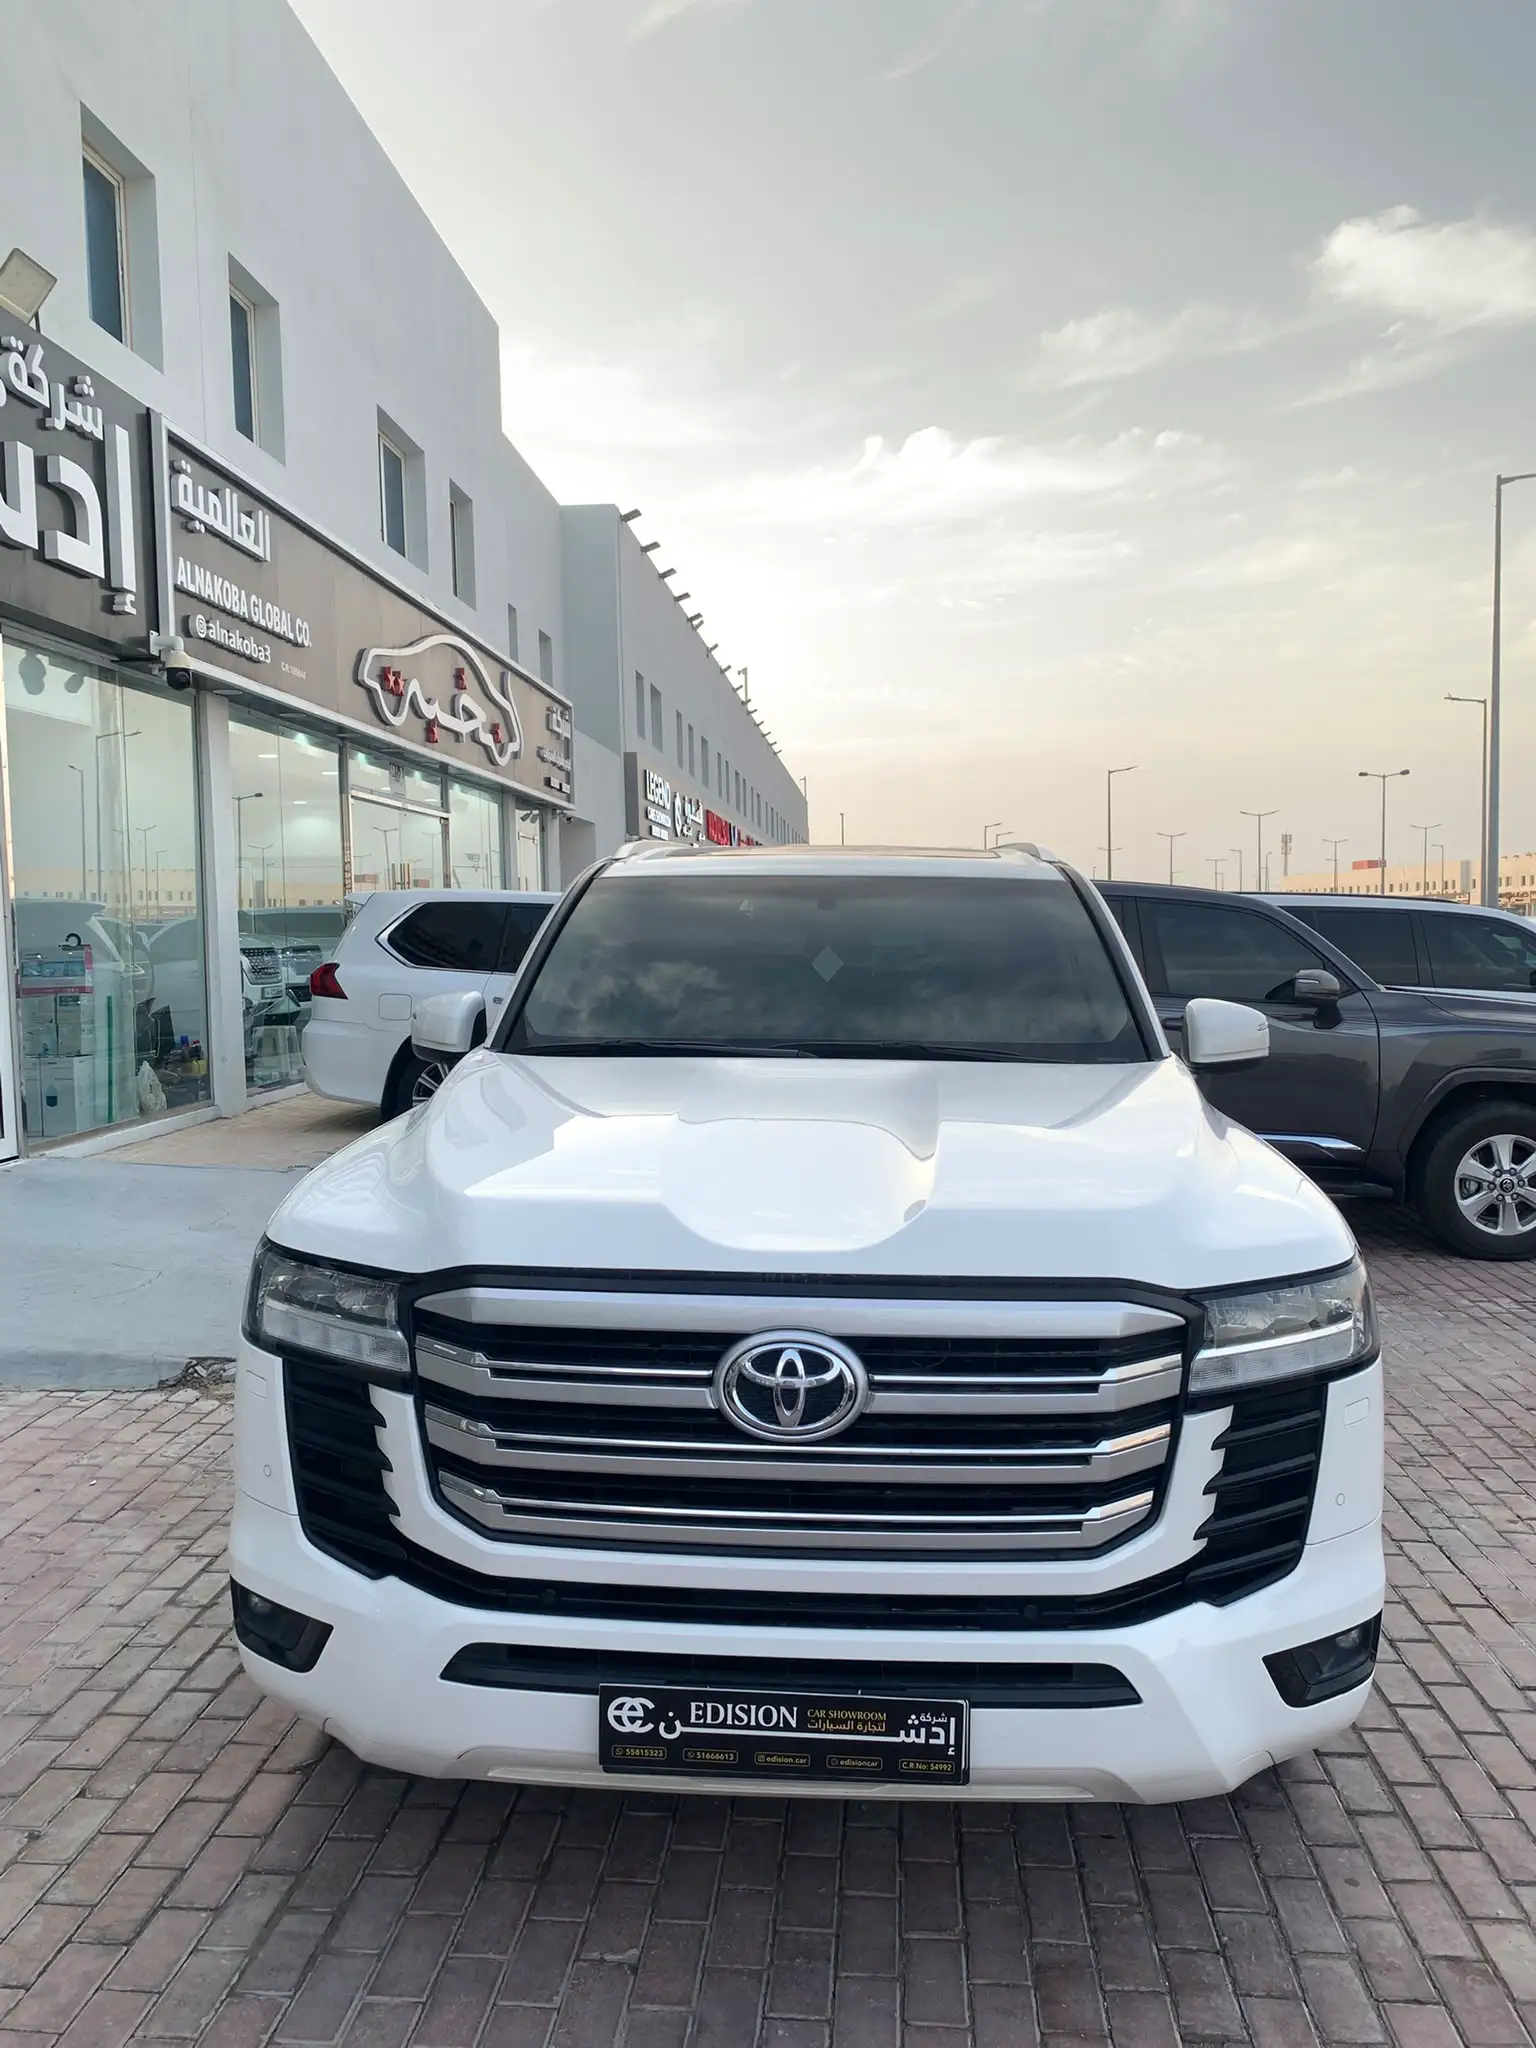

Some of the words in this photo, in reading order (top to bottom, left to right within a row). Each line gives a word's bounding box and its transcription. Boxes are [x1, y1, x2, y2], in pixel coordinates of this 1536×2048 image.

[1, 336, 103, 440] شركة
[173, 460, 271, 562] العالمية
[177, 557, 249, 618] ALNAKOBA
[250, 593, 294, 639] GLOBAL
[295, 617, 312, 647] CO.
[646, 768, 671, 810] LEGEND
[690, 1701, 798, 1728] EDISION
[807, 1709, 826, 1719] CAR
[828, 1710, 887, 1721] SHOWROOM
[920, 1712, 948, 1725] شركة
[807, 1719, 854, 1731] السيارات
[857, 1721, 886, 1733] لتجارة
[625, 1748, 663, 1757] 55815323
[696, 1751, 734, 1761] 51666613
[766, 1755, 807, 1765] edision.car
